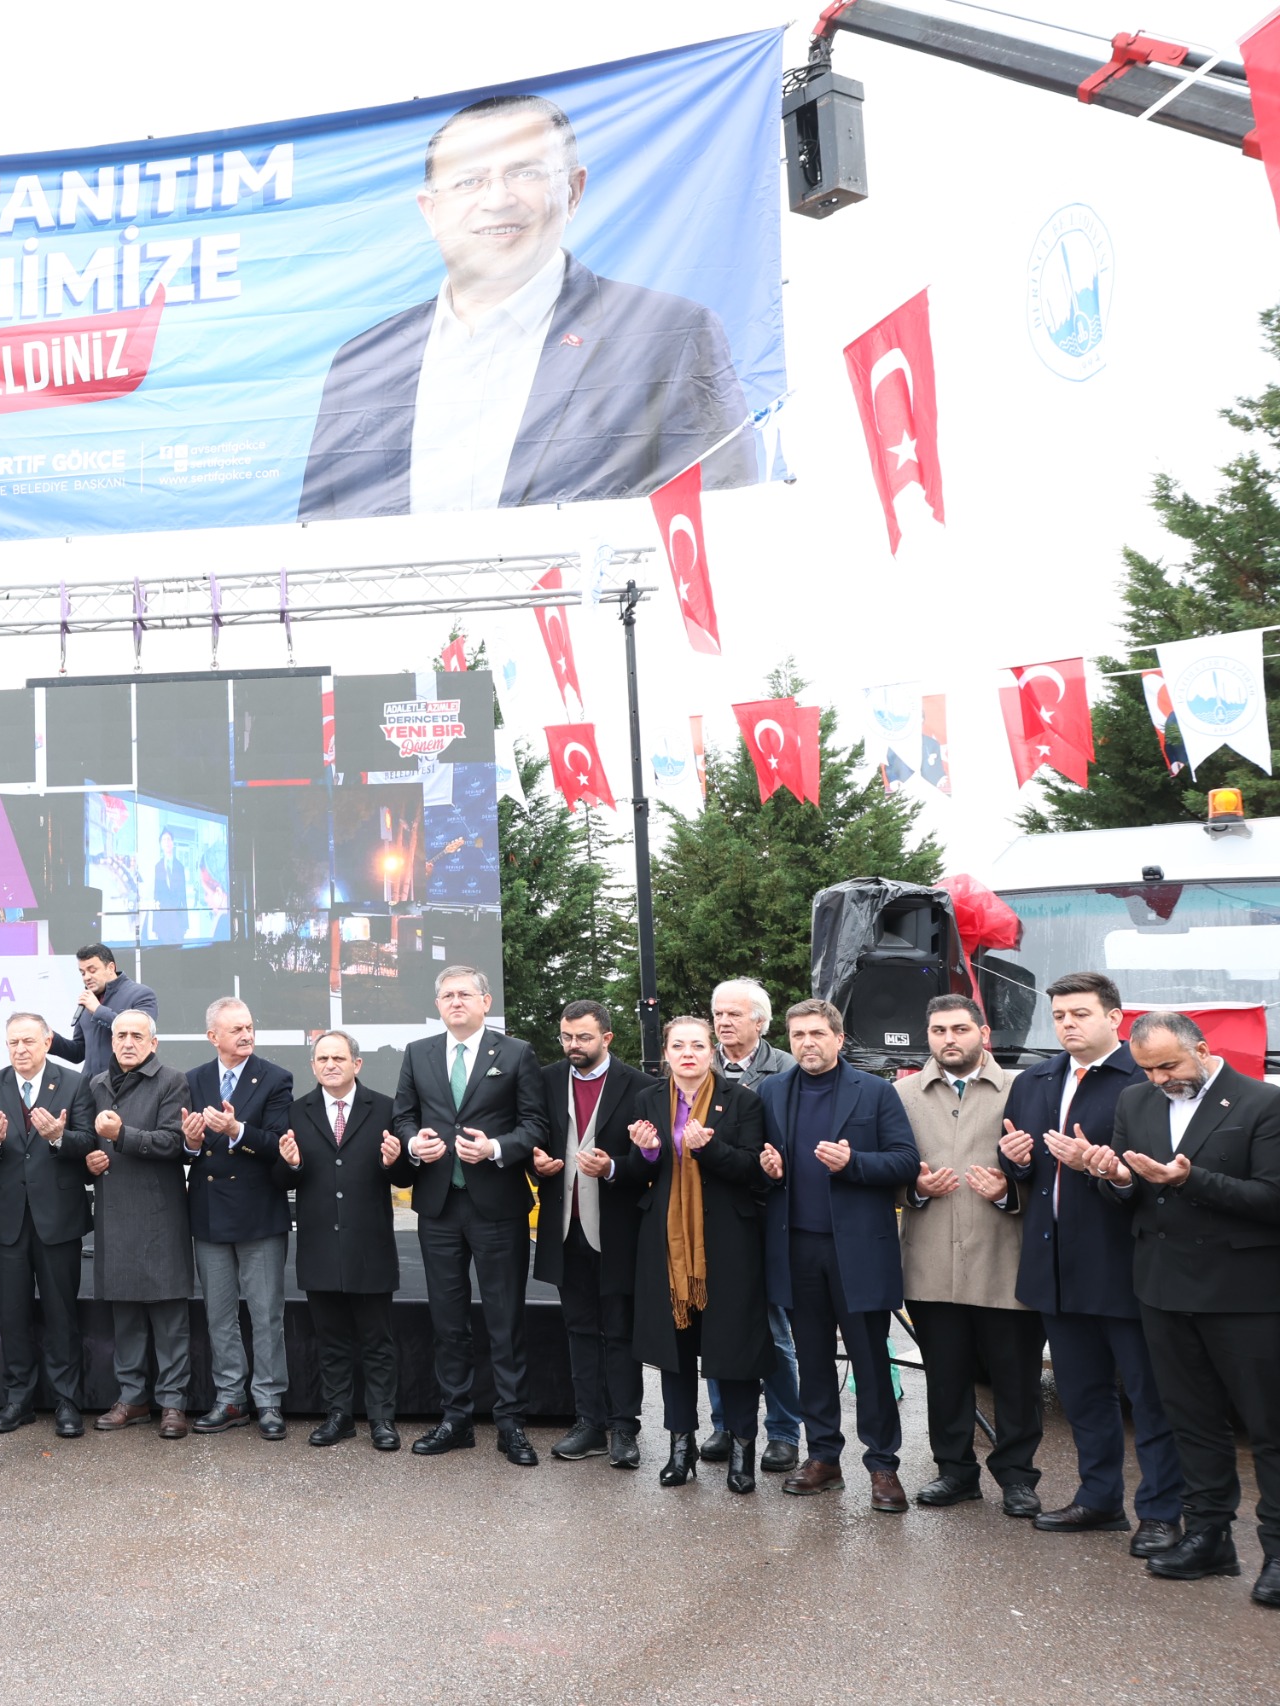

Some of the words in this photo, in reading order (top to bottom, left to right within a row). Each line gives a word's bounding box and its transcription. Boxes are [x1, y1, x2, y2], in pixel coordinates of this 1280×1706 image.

[383, 725, 426, 738] YENİ
[433, 724, 464, 737] BİR
[887, 1034, 907, 1044] MCS
